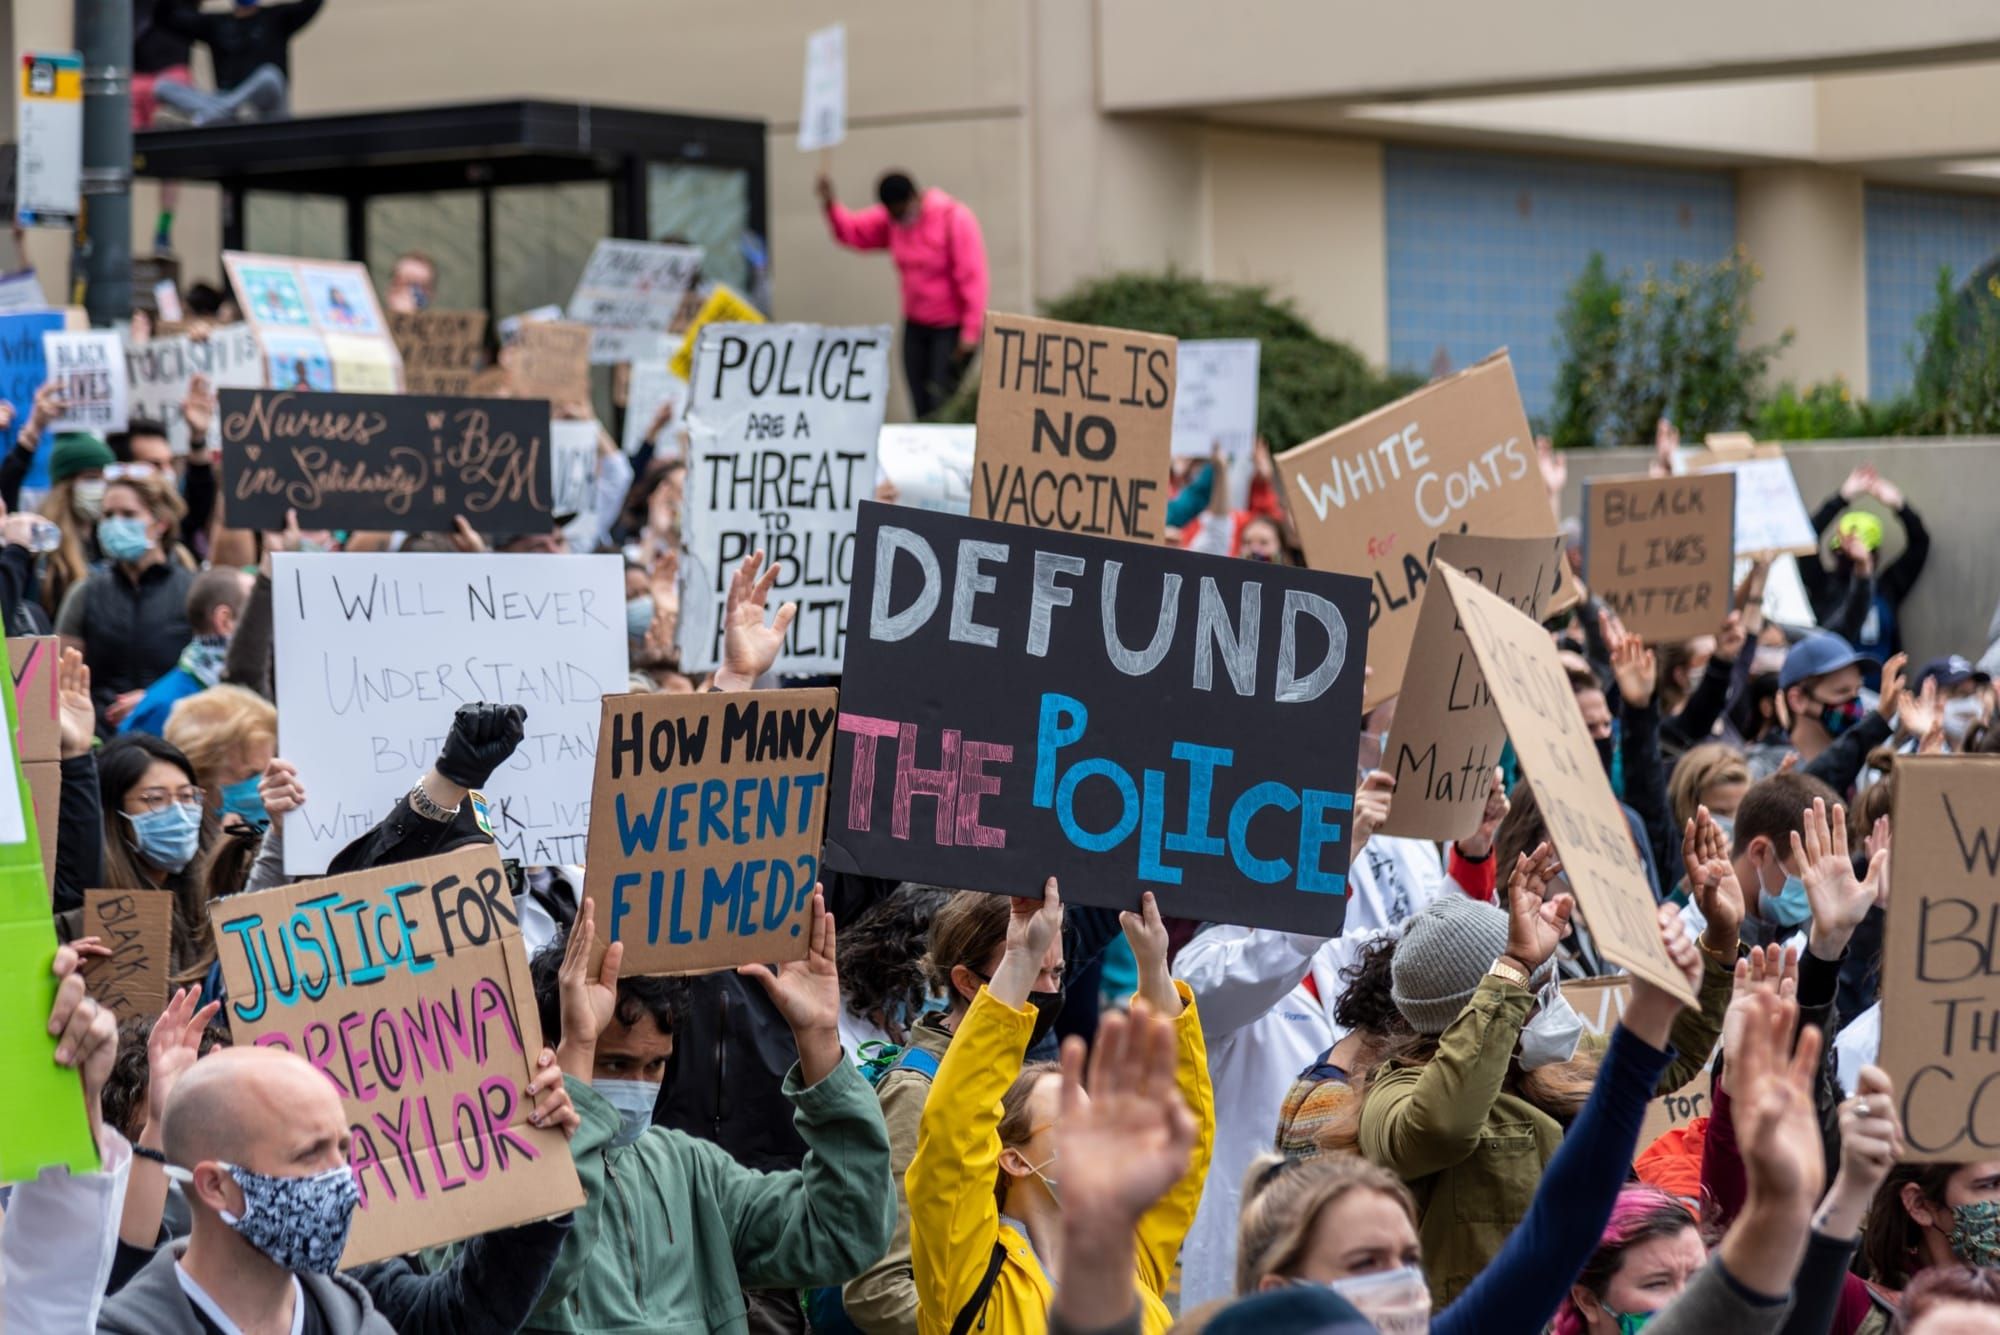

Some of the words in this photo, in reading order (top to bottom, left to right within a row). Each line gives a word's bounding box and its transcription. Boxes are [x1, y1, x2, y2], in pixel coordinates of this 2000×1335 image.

[713, 337, 878, 402] POLICE
[994, 327, 1110, 402] THERE
[1119, 345, 1169, 410] IS
[223, 393, 387, 446] Nurses
[745, 413, 785, 440] ARE
[793, 411, 810, 439] A
[1031, 408, 1117, 461] NO
[236, 466, 286, 499] in
[286, 446, 428, 515] Solidarity
[447, 408, 552, 512] BLM
[704, 451, 867, 511] THREAT
[1297, 422, 1430, 522] WHITE
[1415, 437, 1527, 527] COATS
[758, 511, 790, 532] TO
[981, 461, 1157, 540] VACCINE
[1603, 487, 1704, 527] BLACK
[1366, 532, 1399, 559] for
[1616, 534, 1707, 577] LIVES
[296, 568, 305, 620] I
[332, 573, 445, 622] WILL
[468, 575, 610, 630] NEVER
[869, 525, 1348, 702] DEFUND
[1603, 582, 1711, 616] MATTER
[323, 651, 602, 716] UNDERSTAND
[372, 736, 447, 774] BUT
[509, 722, 598, 772] STAN
[612, 711, 709, 779] HOW
[720, 700, 835, 764] MANY
[837, 712, 1014, 849] THE
[1033, 692, 1354, 896] POLICE
[302, 801, 373, 842] WITH
[524, 794, 591, 829] LIVE
[615, 772, 825, 857] WERENT
[494, 832, 587, 866] MATT
[611, 854, 817, 946] FILMED?
[97, 895, 150, 982] BLACK
[221, 881, 437, 1022] JUSTICE
[431, 867, 521, 958] FOR
[347, 1075, 541, 1212] AYLOR
